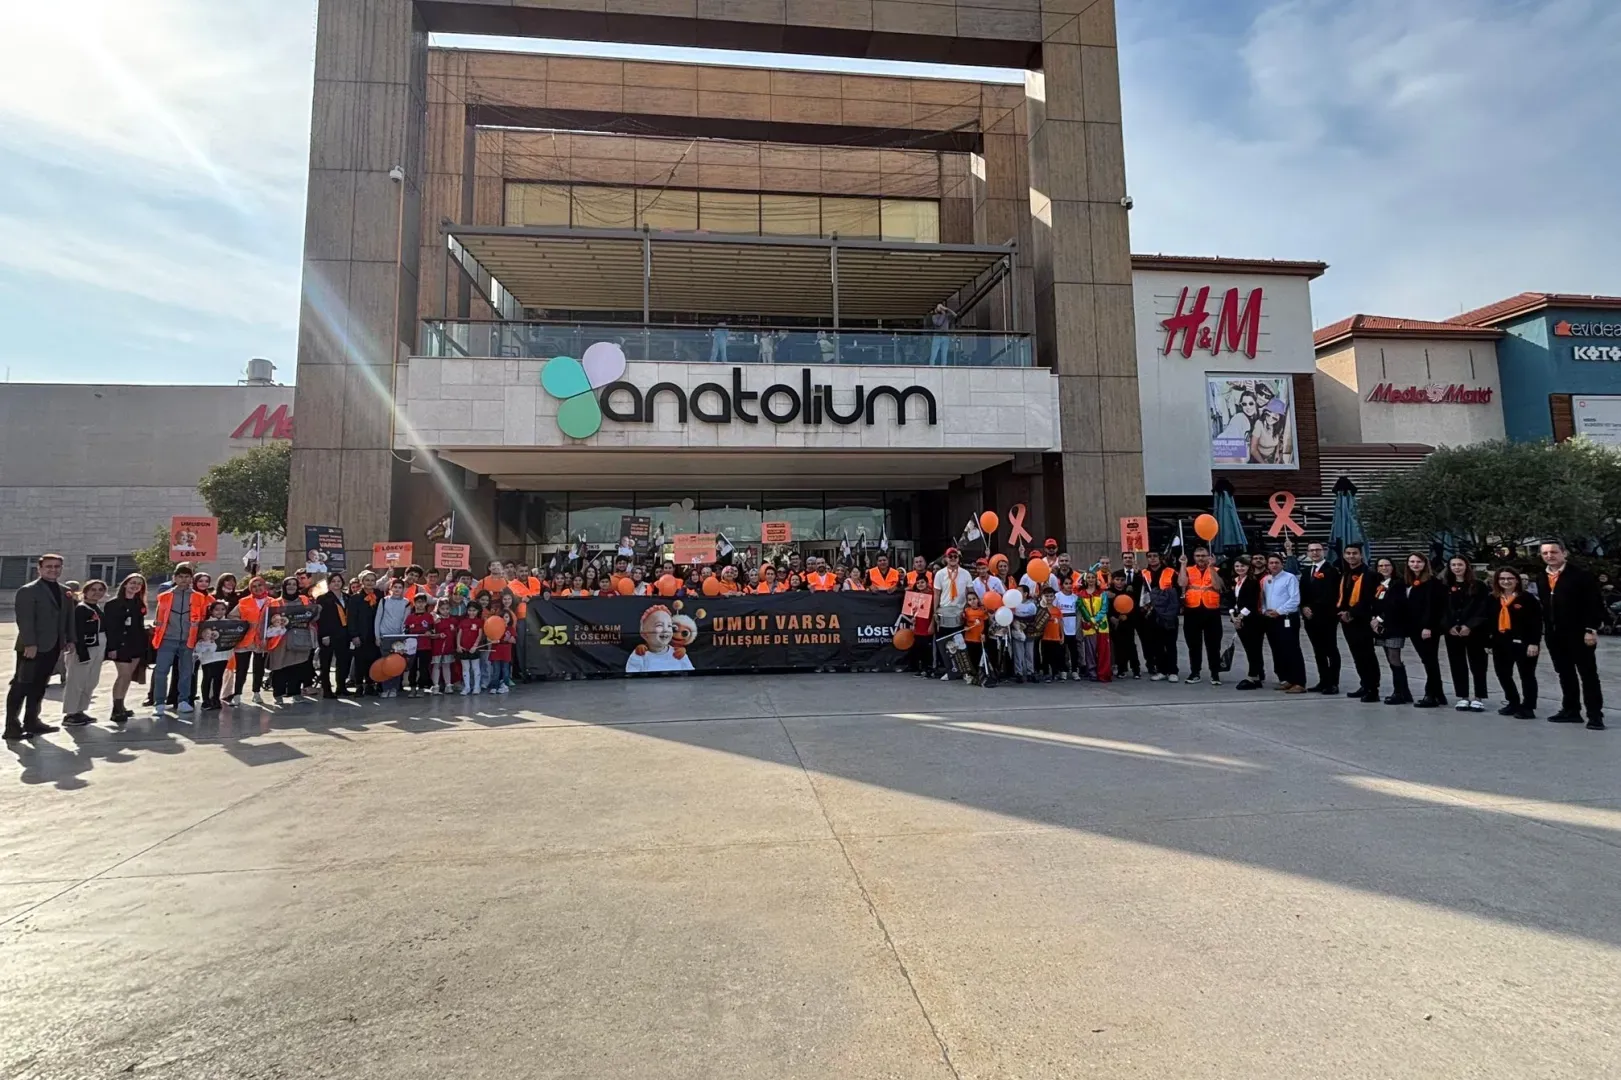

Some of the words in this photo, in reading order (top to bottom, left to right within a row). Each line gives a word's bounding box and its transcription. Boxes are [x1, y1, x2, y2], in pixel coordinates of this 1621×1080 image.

[1160, 286, 1263, 359] H&M
[1571, 322, 1621, 337] evidea
[600, 367, 937, 425] anatolium
[1366, 383, 1427, 404] Media
[1441, 384, 1493, 404] Markt
[592, 624, 621, 632] KASIM
[713, 616, 768, 631] UMUT
[775, 614, 840, 630] VARSA
[857, 625, 898, 636] LÖSEV
[540, 625, 571, 645] 25.
[574, 632, 621, 640] LÖSEMİLİ
[713, 634, 770, 647] İYİLEŞME
[774, 634, 789, 644] DE
[794, 633, 840, 644] VARDIR
